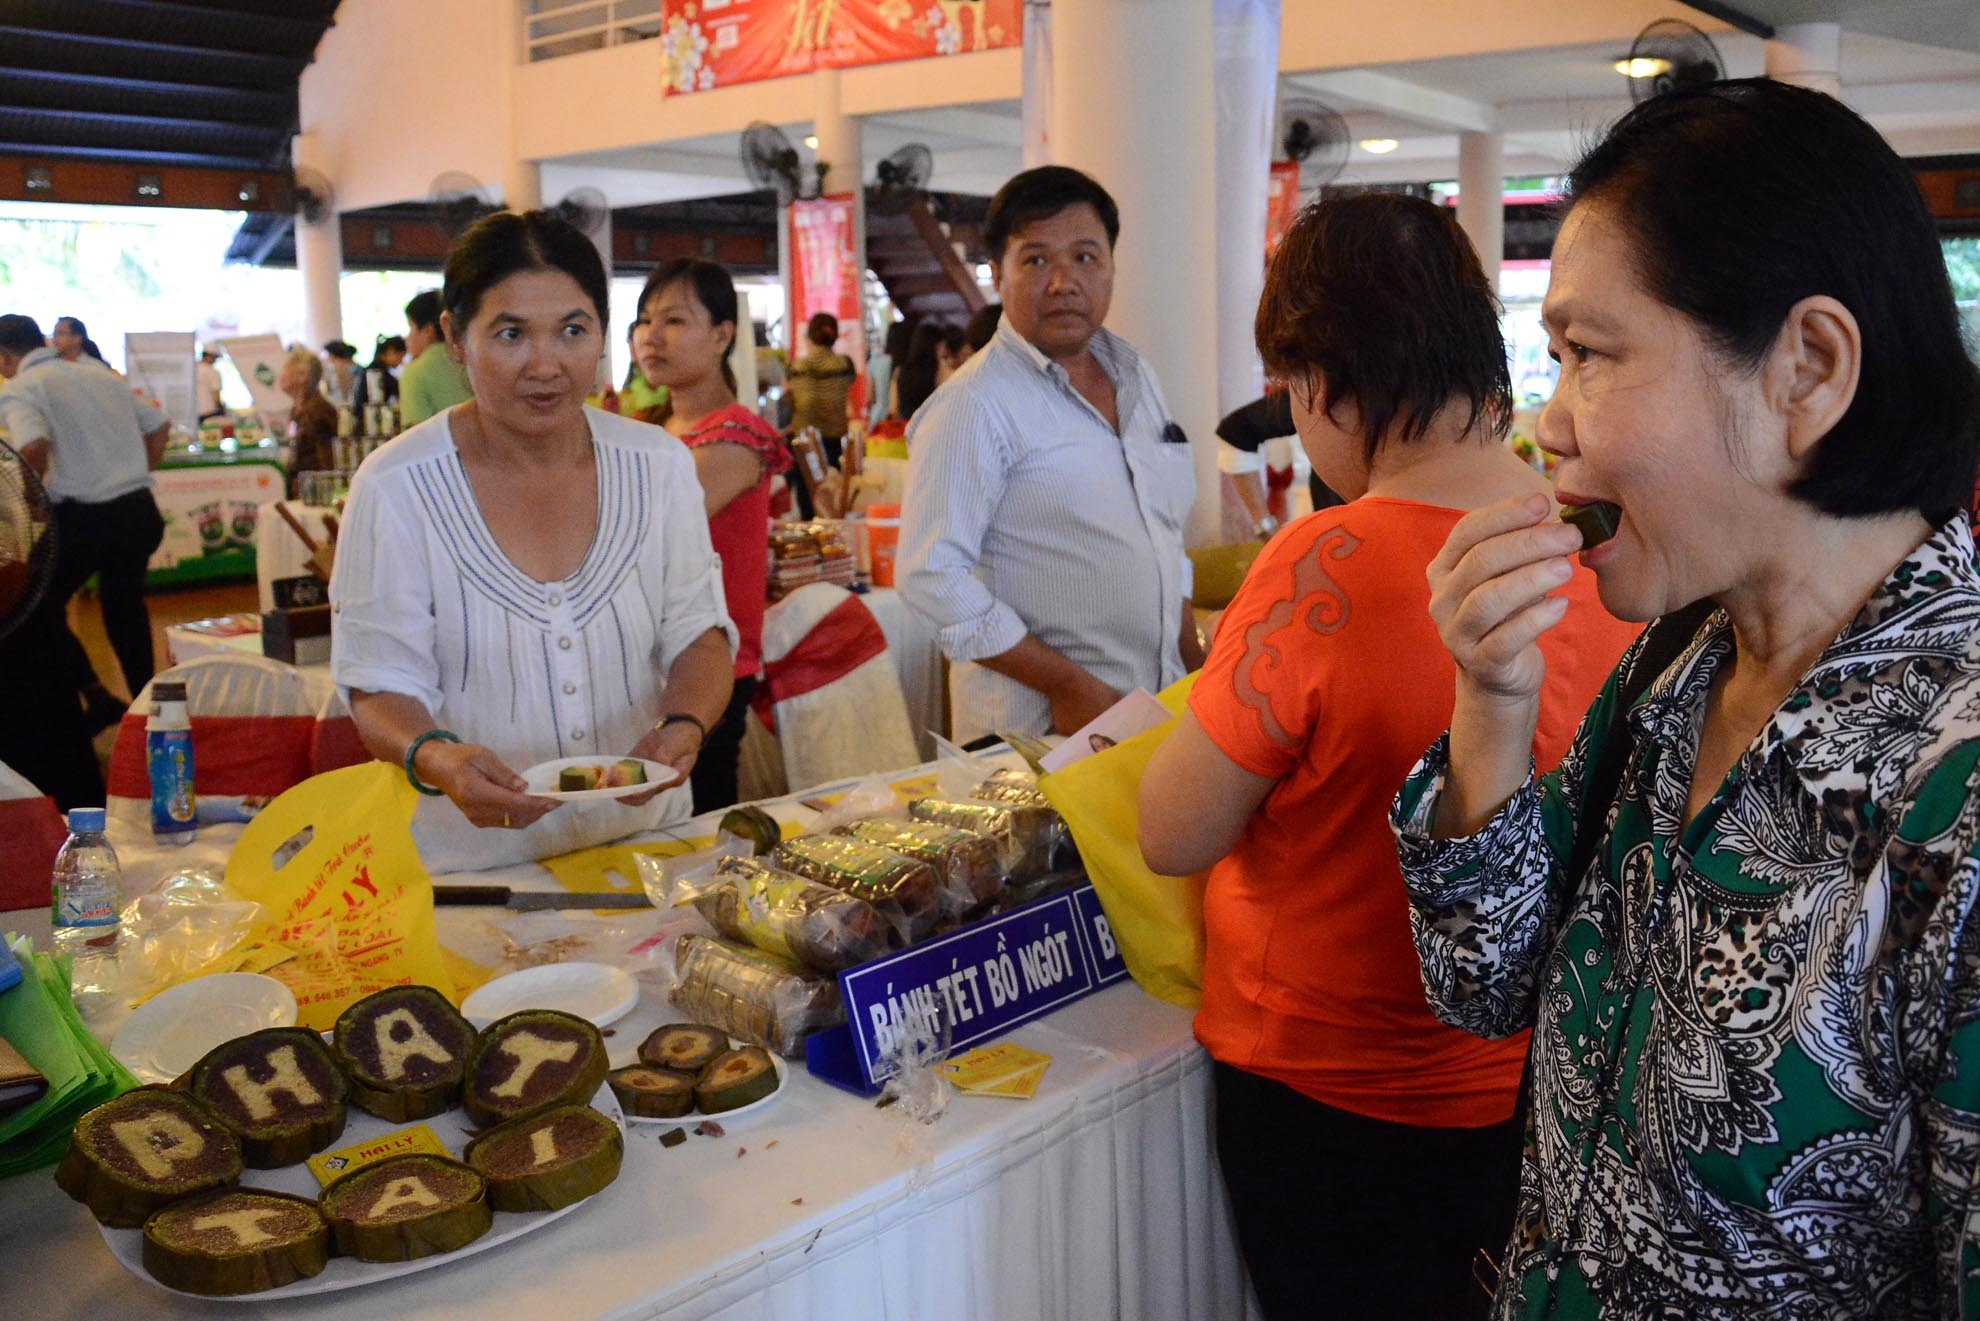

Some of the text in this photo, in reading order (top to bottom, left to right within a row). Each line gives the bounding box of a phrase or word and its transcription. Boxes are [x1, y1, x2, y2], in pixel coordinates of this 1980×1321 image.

[868, 922, 1074, 1053] BÁNH TÉT BỒ NGÓT
